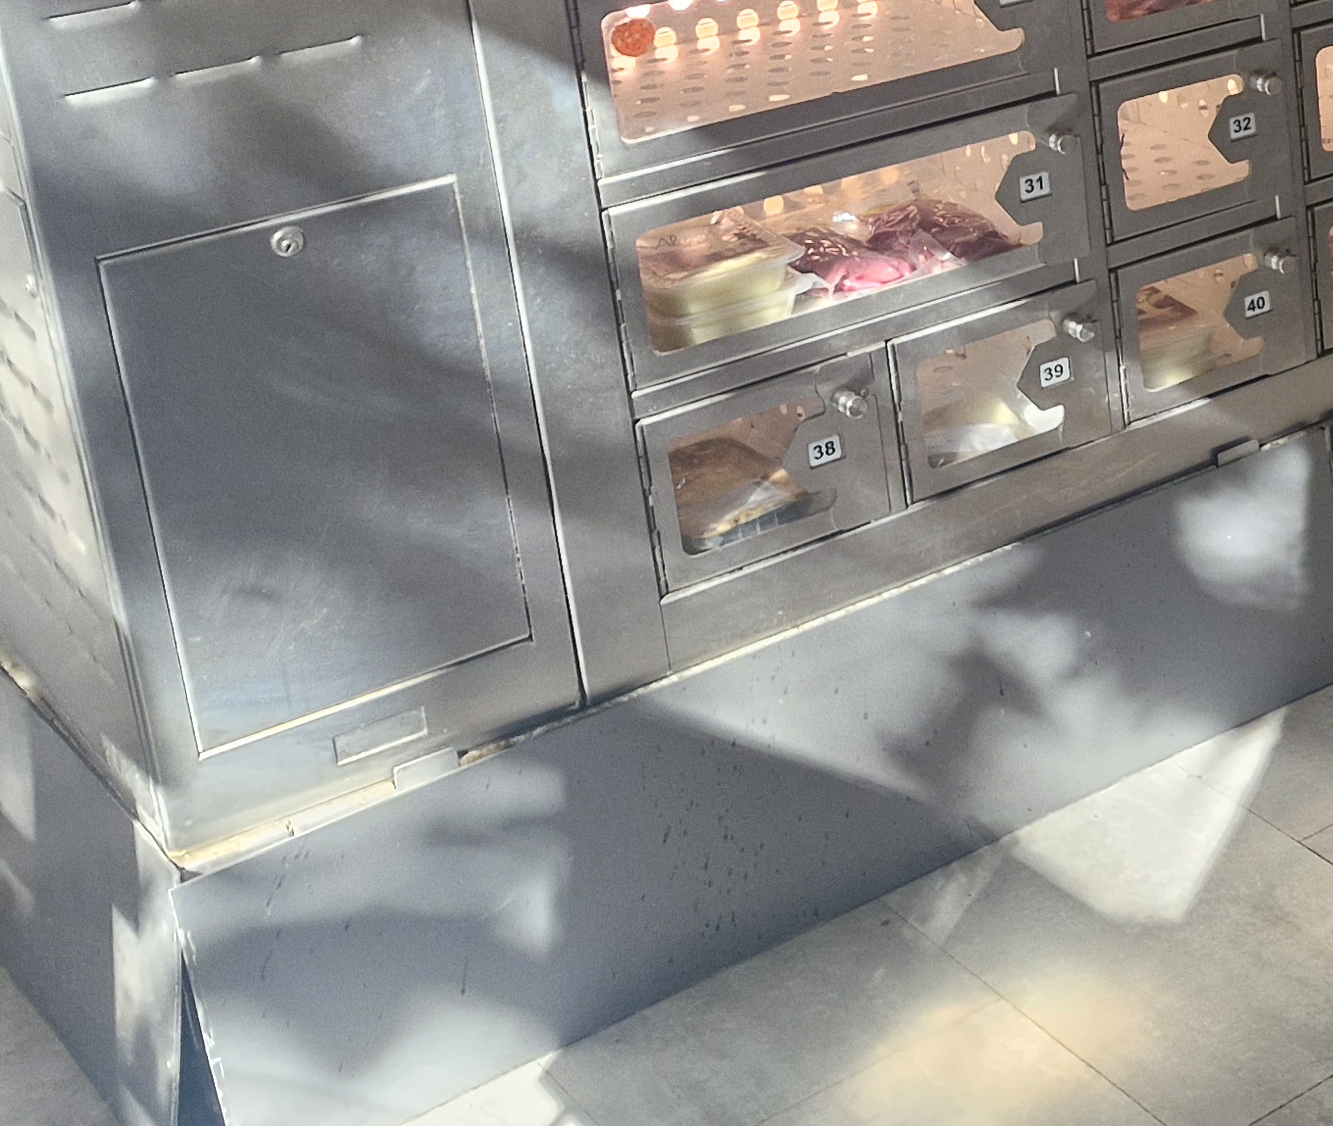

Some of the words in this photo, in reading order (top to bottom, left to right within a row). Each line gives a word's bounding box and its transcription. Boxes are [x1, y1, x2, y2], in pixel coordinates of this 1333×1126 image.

[1233, 117, 1252, 133] 32
[1025, 176, 1043, 193] 31
[1247, 297, 1265, 311] 40
[1044, 364, 1063, 381] 39
[814, 441, 836, 460] 38
